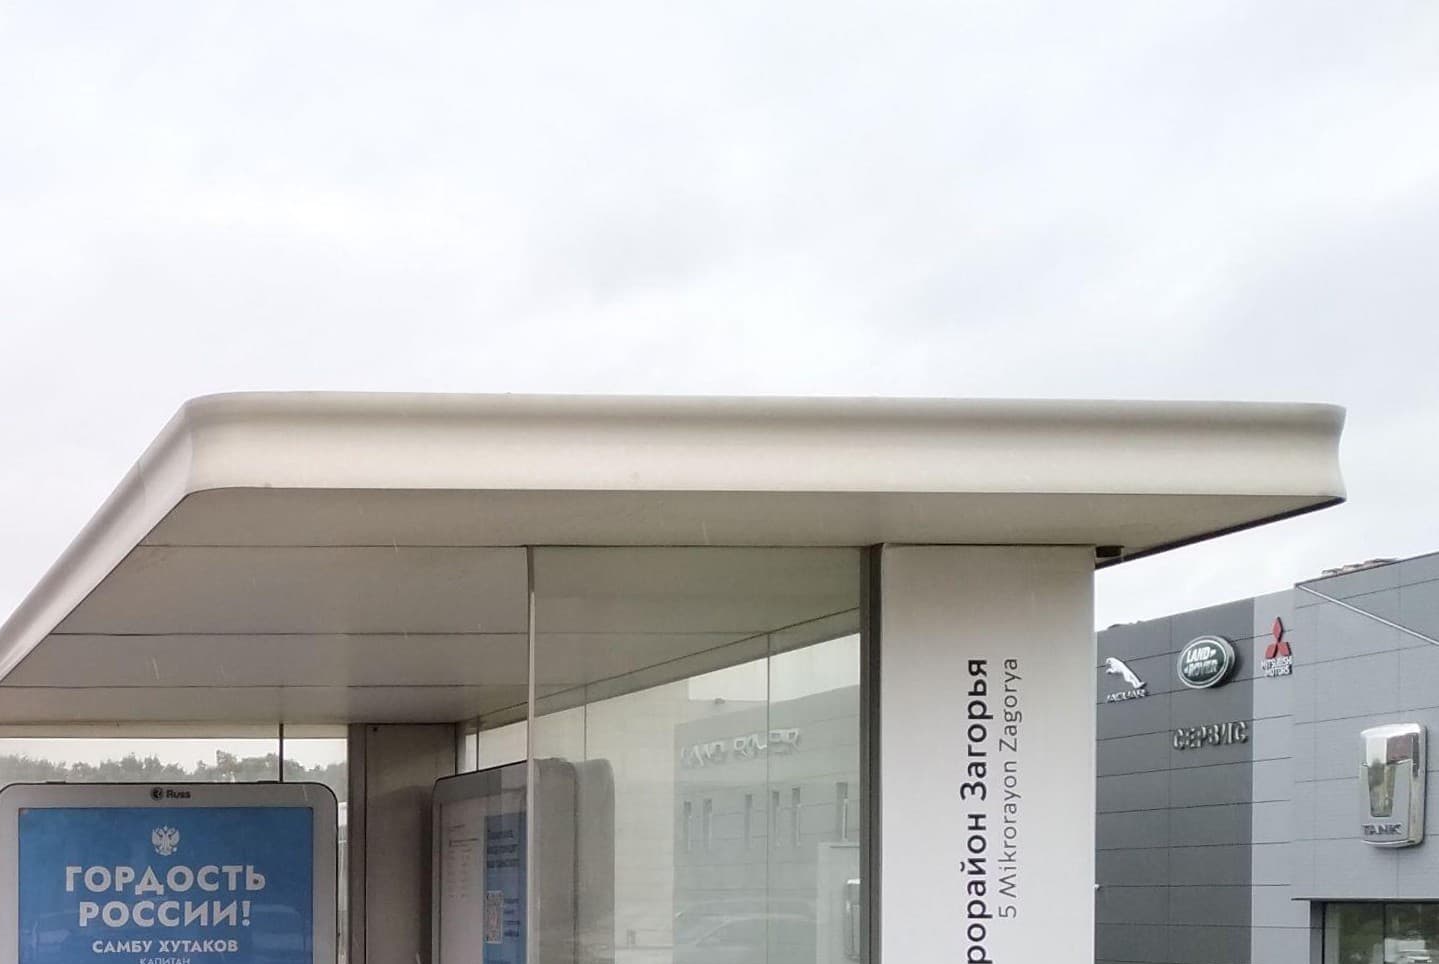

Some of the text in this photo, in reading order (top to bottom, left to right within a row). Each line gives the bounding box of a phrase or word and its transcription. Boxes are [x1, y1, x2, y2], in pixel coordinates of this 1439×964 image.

[1186, 647, 1211, 663] LAND
[960, 658, 993, 801] Загорья
[1173, 721, 1248, 750] СЕРВИС
[998, 657, 1023, 919] 5 Mikrorayon Zagorya
[1361, 823, 1402, 836] TANK
[65, 864, 266, 895] ГОРДОСТЬ
[79, 900, 251, 928] РОССИИ!
[92, 939, 239, 954] САМБУ ХУТАКОВ
